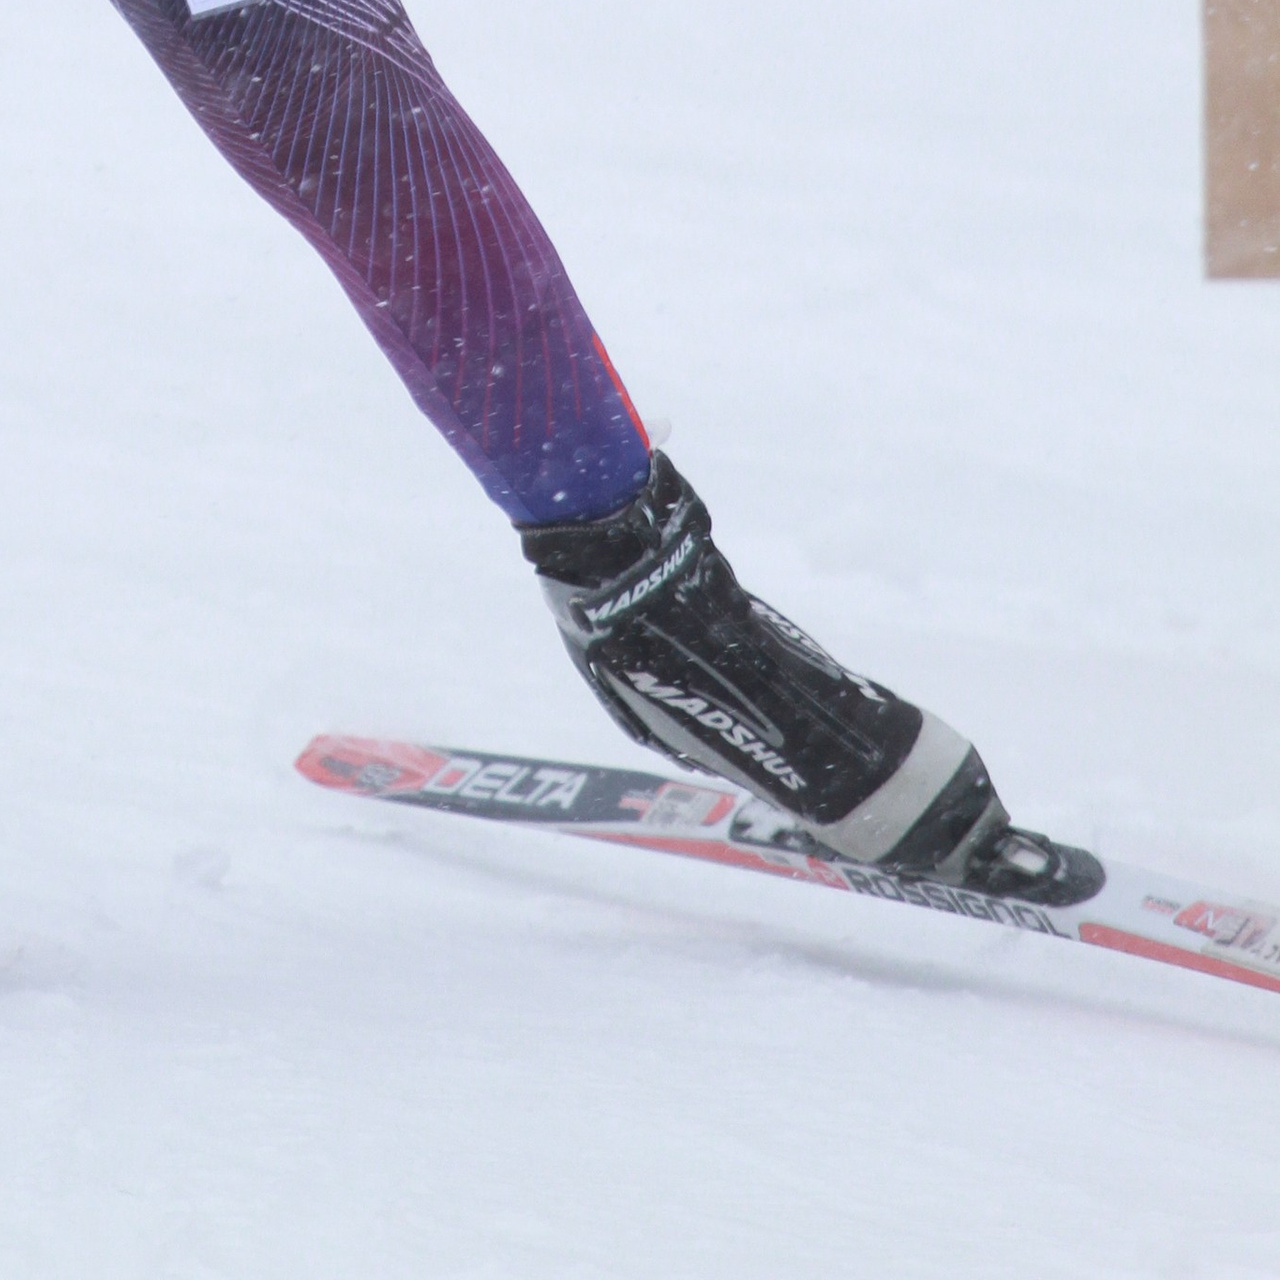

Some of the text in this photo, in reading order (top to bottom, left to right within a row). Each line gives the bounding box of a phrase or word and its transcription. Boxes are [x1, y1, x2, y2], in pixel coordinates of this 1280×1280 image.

[584, 533, 695, 622] MADSHUS
[624, 671, 810, 793] MADSHUS
[421, 757, 591, 811] DELTA
[838, 866, 1074, 941] ROSSIGNOL
